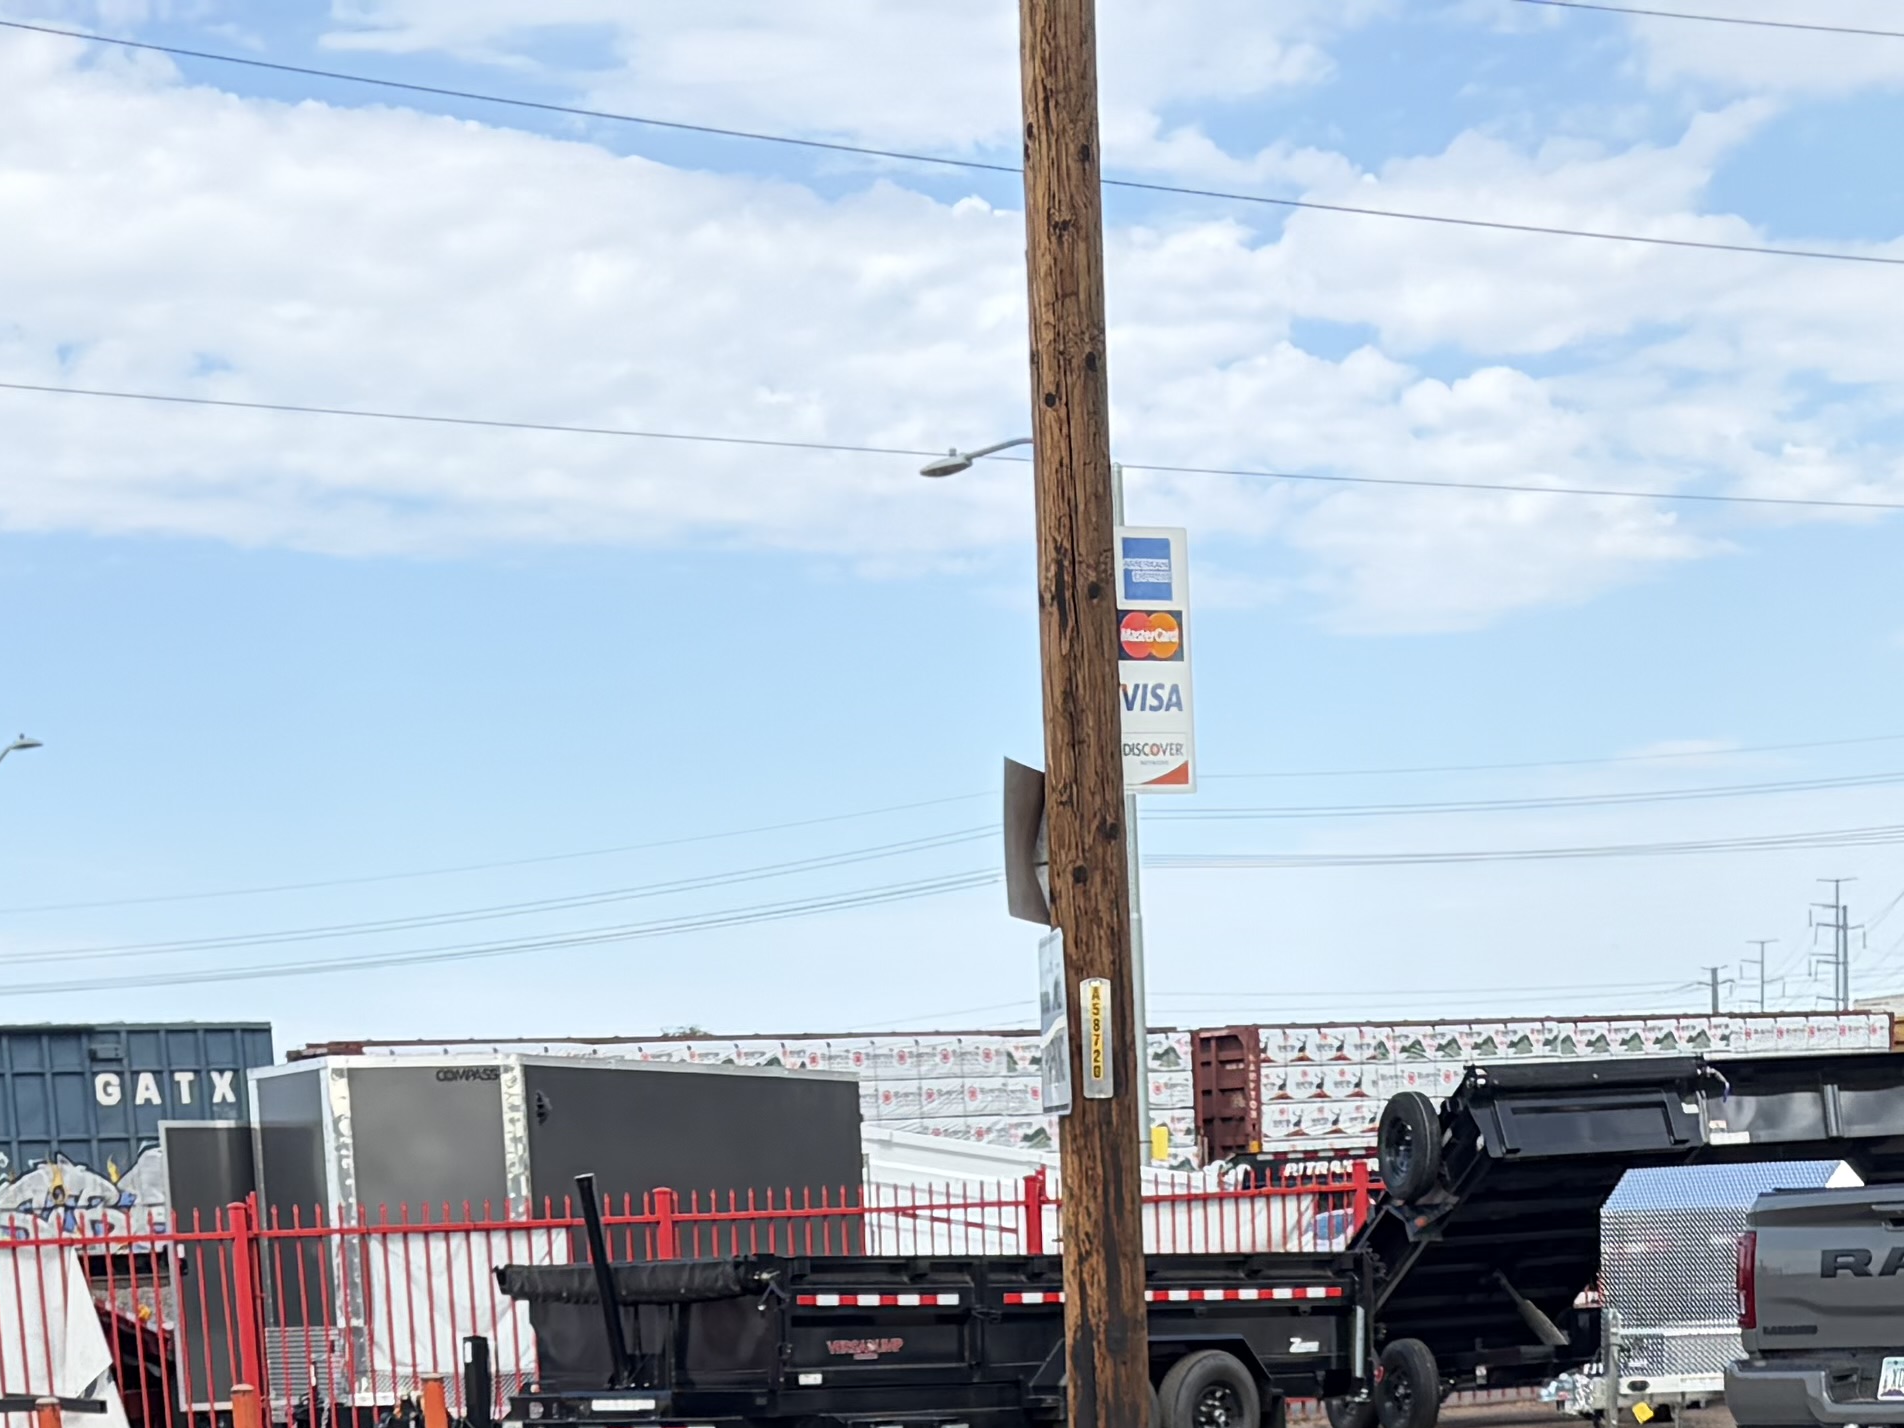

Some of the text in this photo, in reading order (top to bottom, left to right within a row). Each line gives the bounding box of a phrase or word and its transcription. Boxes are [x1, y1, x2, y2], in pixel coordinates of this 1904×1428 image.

[1120, 683, 1183, 712] VISA
[1123, 742, 1185, 757] DISCOVER
[435, 1067, 500, 1082] COMPASS
[94, 1070, 237, 1106] GATX
